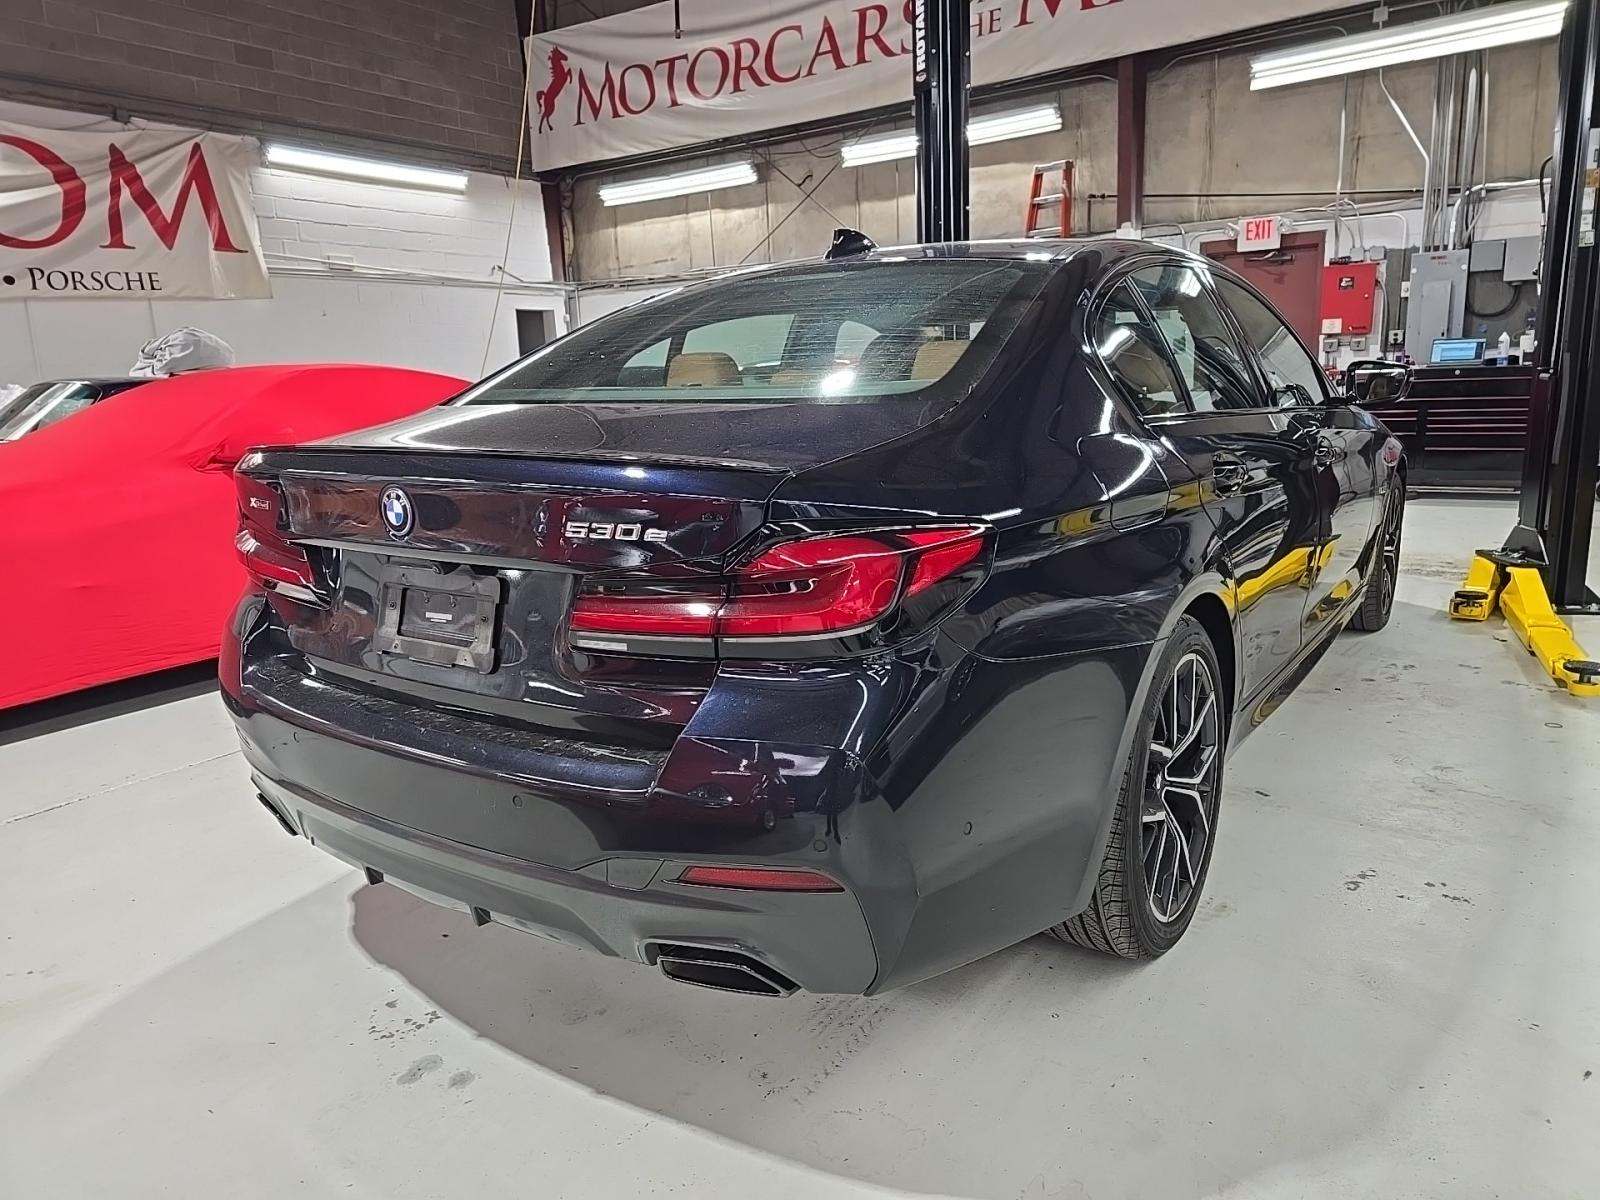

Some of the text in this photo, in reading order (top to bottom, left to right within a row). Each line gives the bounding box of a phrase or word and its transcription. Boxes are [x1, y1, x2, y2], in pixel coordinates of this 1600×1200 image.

[969, 8, 1002, 38] HE
[1246, 219, 1273, 241] EXIT
[28, 267, 163, 291] PORSCHE
[564, 521, 668, 542] 530e
